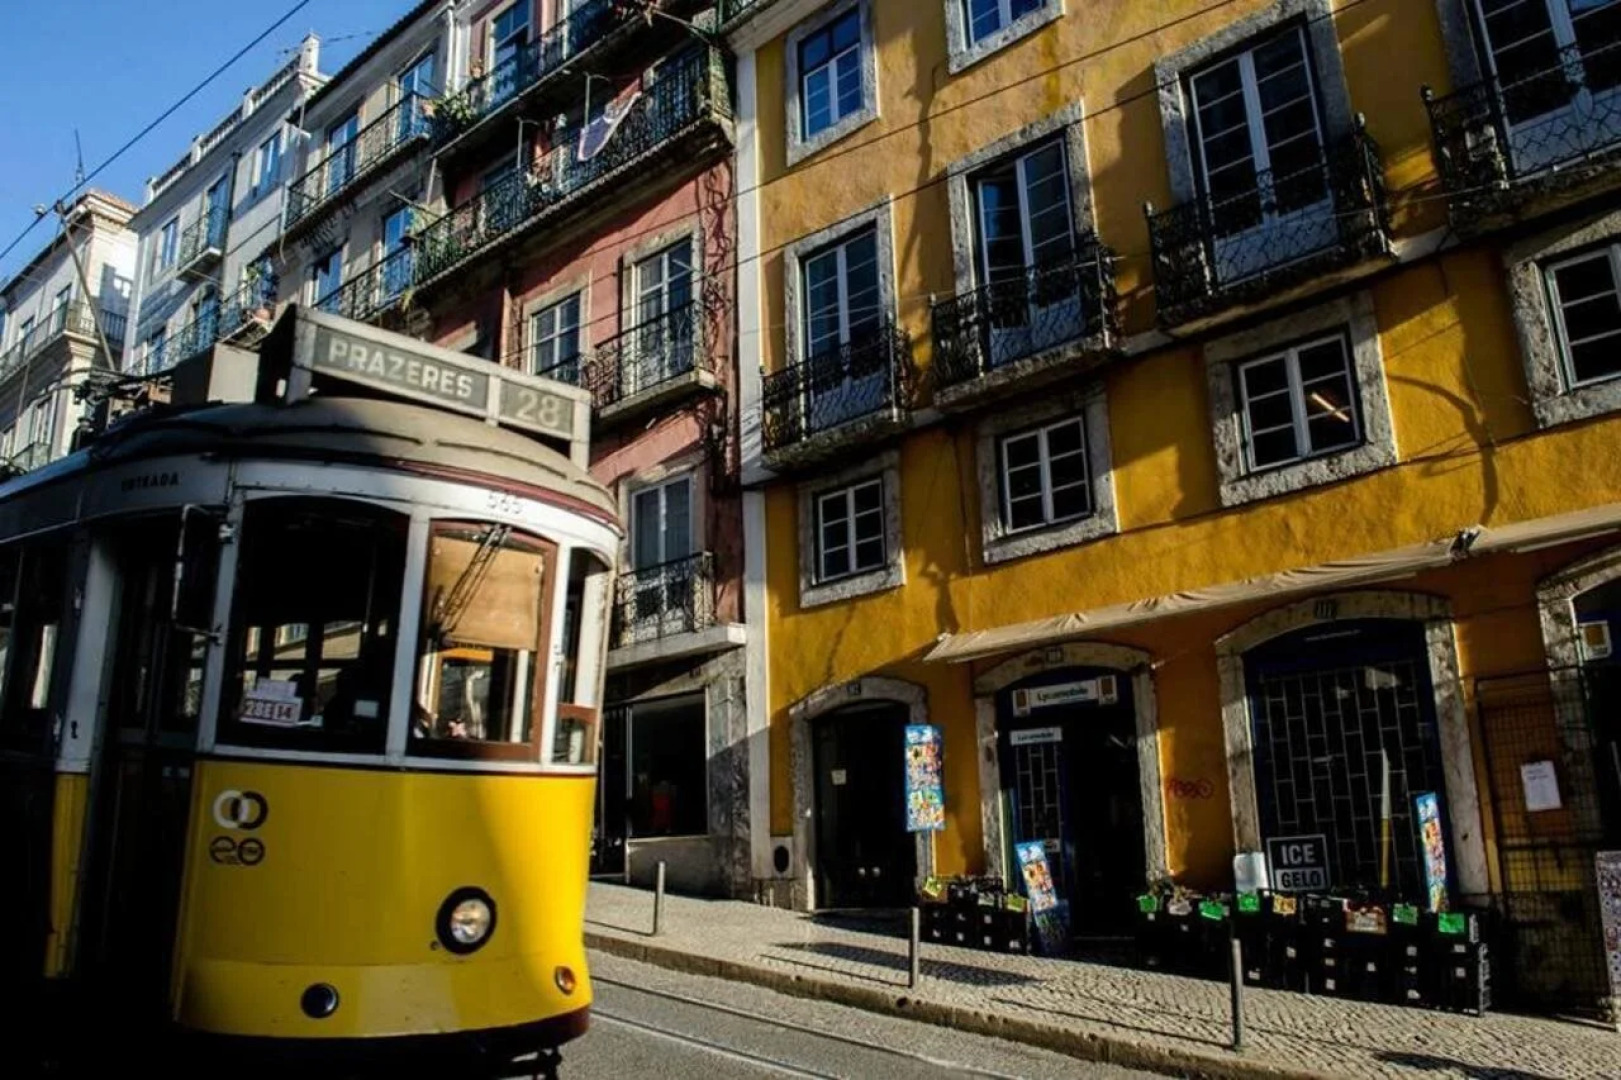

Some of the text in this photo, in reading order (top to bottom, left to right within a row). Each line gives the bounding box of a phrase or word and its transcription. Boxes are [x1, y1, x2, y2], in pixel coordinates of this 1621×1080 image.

[327, 336, 561, 429] PRAZERES 28
[1281, 843, 1316, 866] ICE
[1281, 870, 1322, 889] GELO
